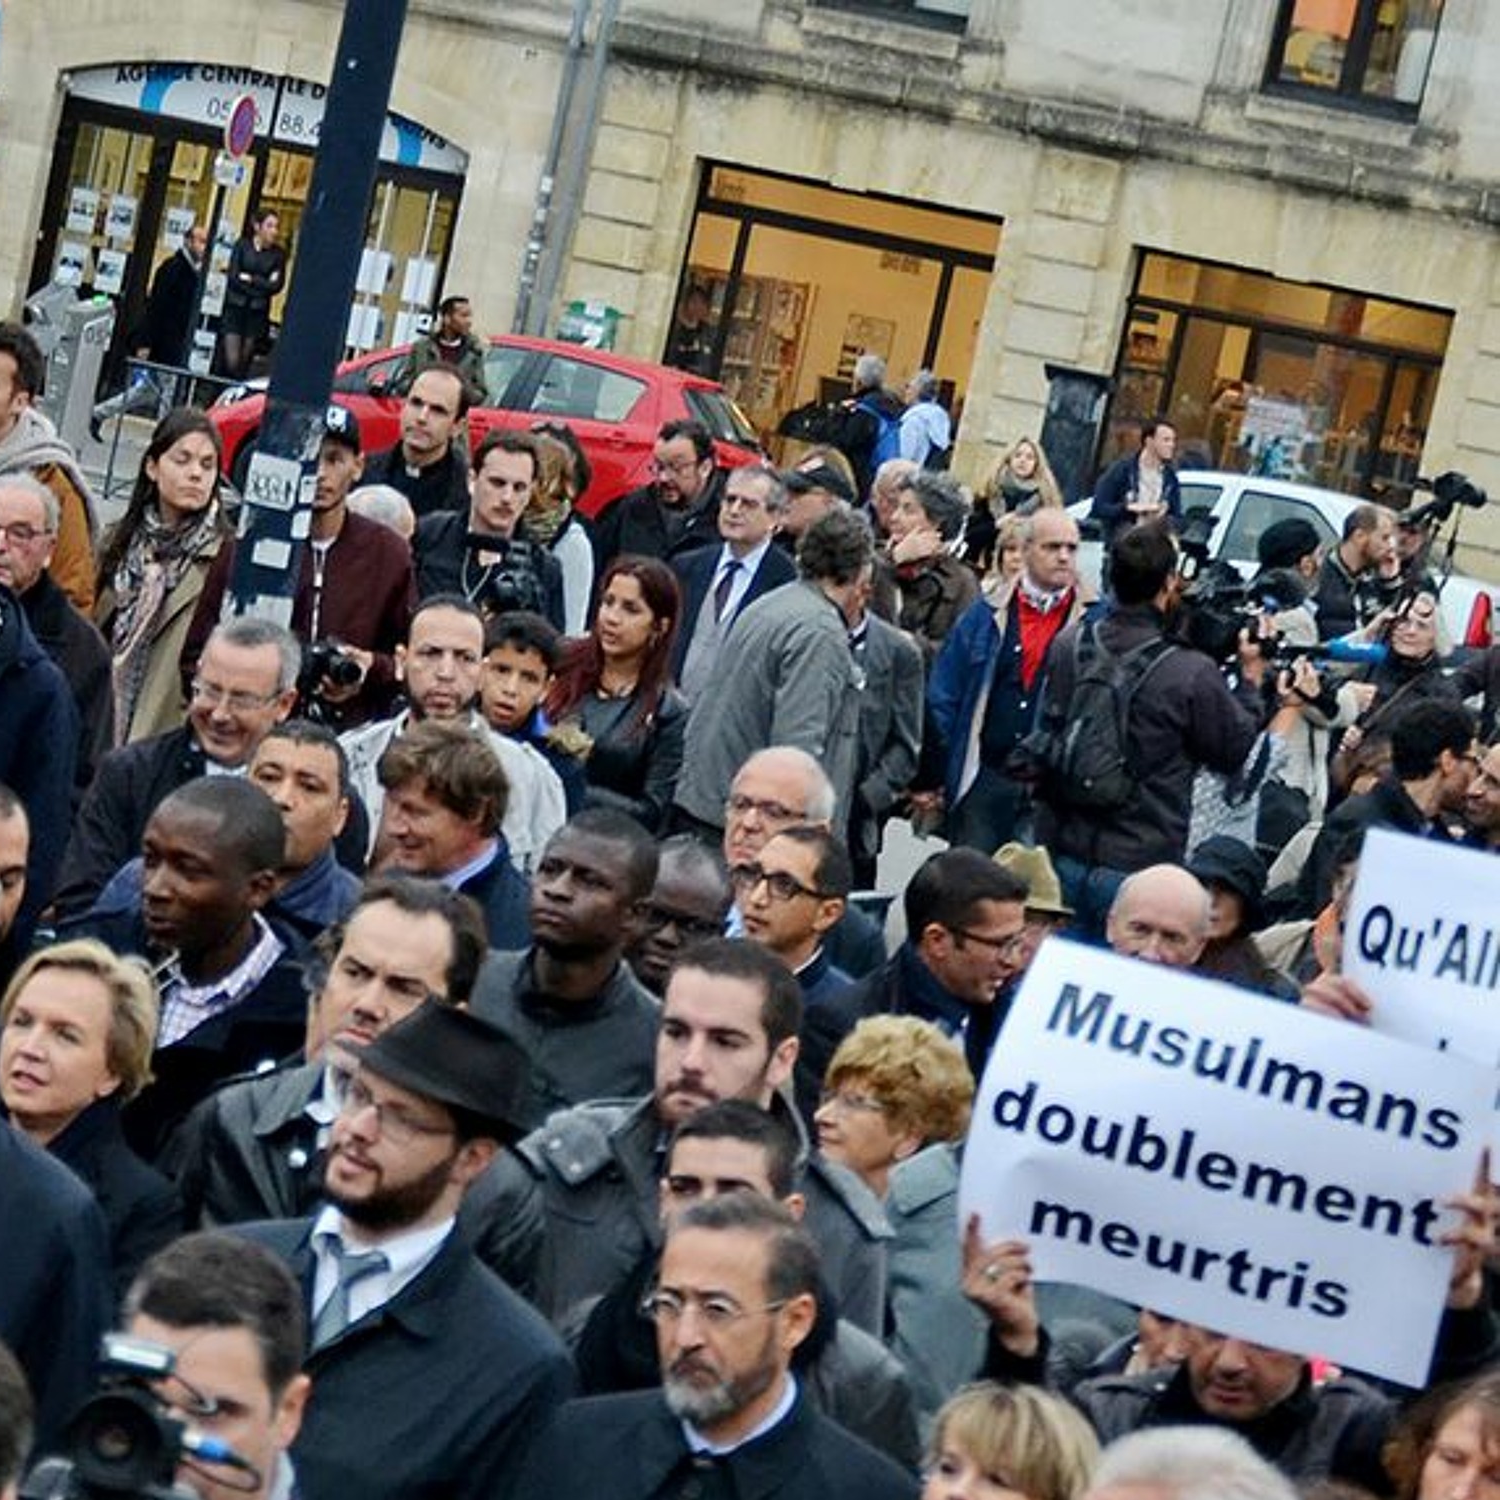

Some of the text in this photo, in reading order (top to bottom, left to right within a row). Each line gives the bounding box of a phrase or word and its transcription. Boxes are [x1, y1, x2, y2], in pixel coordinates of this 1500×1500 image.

[1046, 982, 1461, 1151] Musulmans
[993, 1081, 1441, 1247] doublement
[1030, 1199, 1350, 1320] meurtris
